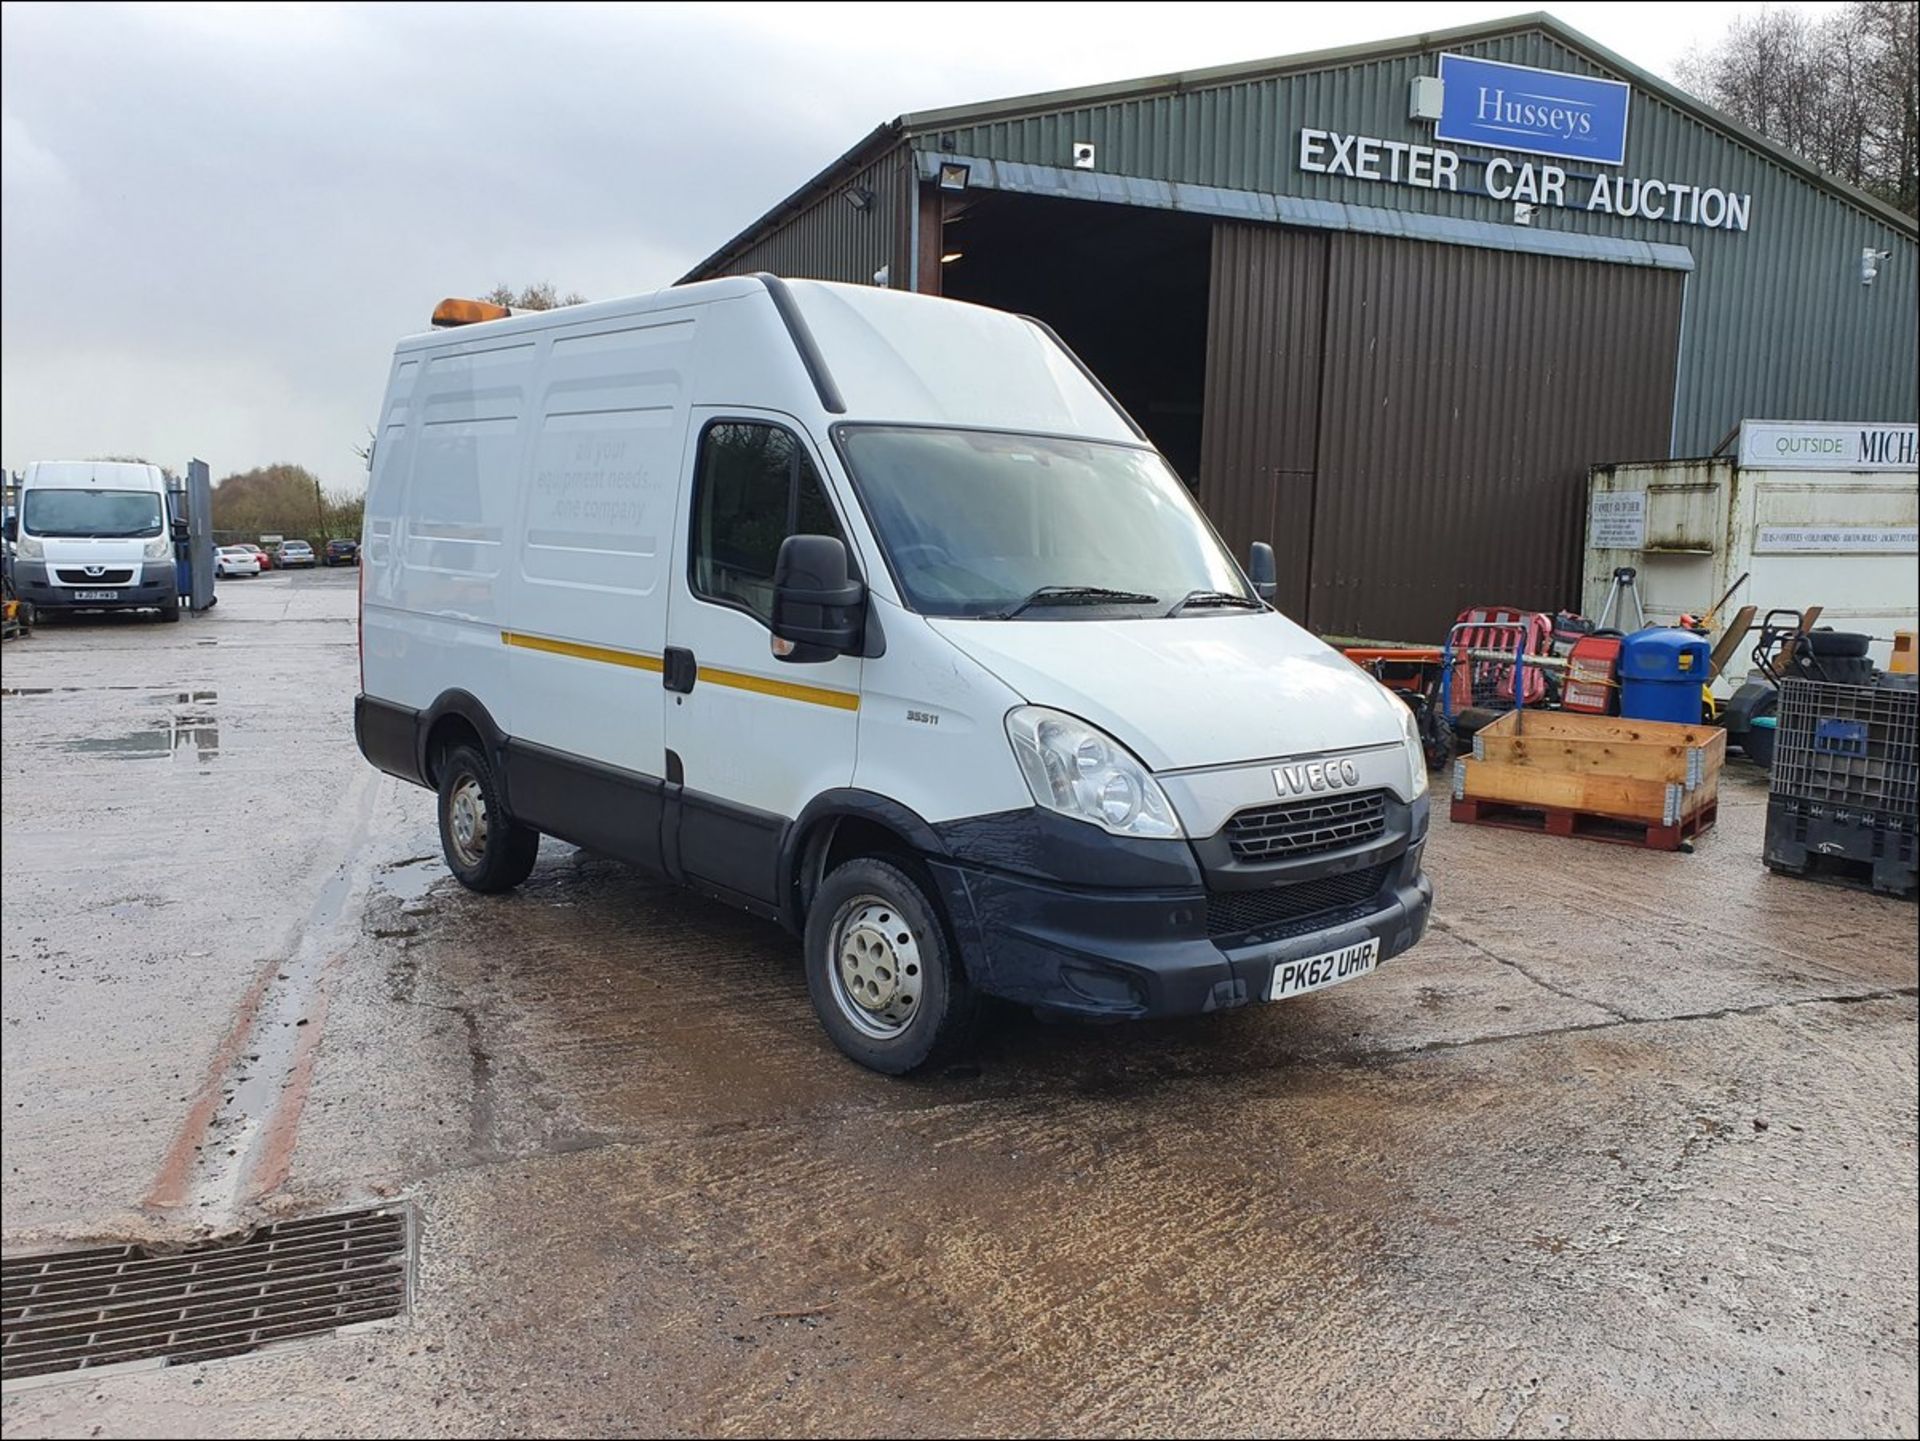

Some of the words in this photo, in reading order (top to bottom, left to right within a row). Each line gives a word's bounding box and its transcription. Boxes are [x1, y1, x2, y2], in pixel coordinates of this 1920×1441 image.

[1477, 87, 1591, 139] Husseys
[1300, 127, 1459, 190] EXETER
[1485, 157, 1566, 206] CAR
[1586, 173, 1750, 230] AUCTION
[594, 440, 626, 466] your
[537, 468, 604, 495] equipment
[583, 499, 647, 527] company
[907, 710, 939, 725] 35S11
[1272, 759, 1359, 796] IVECO
[1280, 956, 1334, 993] PK62
[1338, 943, 1374, 977] UHR
